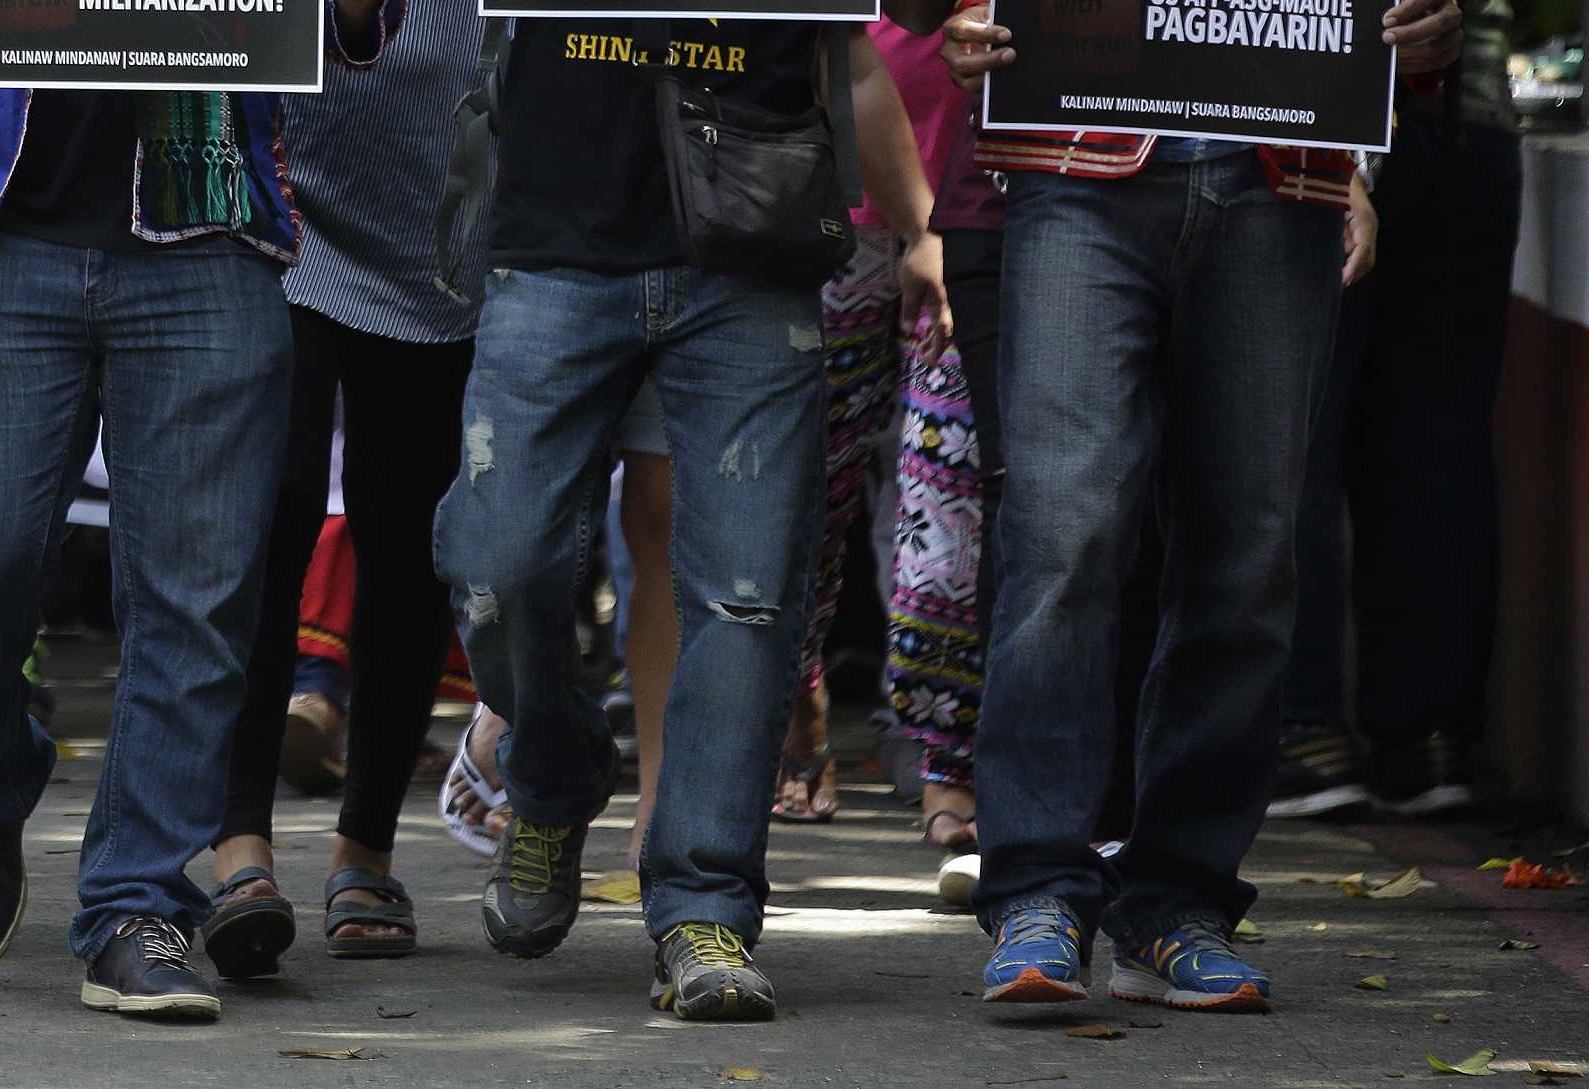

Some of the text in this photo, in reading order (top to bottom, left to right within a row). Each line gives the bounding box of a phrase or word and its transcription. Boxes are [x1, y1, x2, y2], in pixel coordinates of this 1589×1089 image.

[1146, 6, 1354, 54] PAGBAYARIN!
[1, 50, 248, 67] KALINAW MINDANAW SUARA BANGSAMORO
[665, 40, 746, 73] STAR
[1060, 95, 1316, 125] KALINAW MINDANAW SUARA BANGSAMORO
